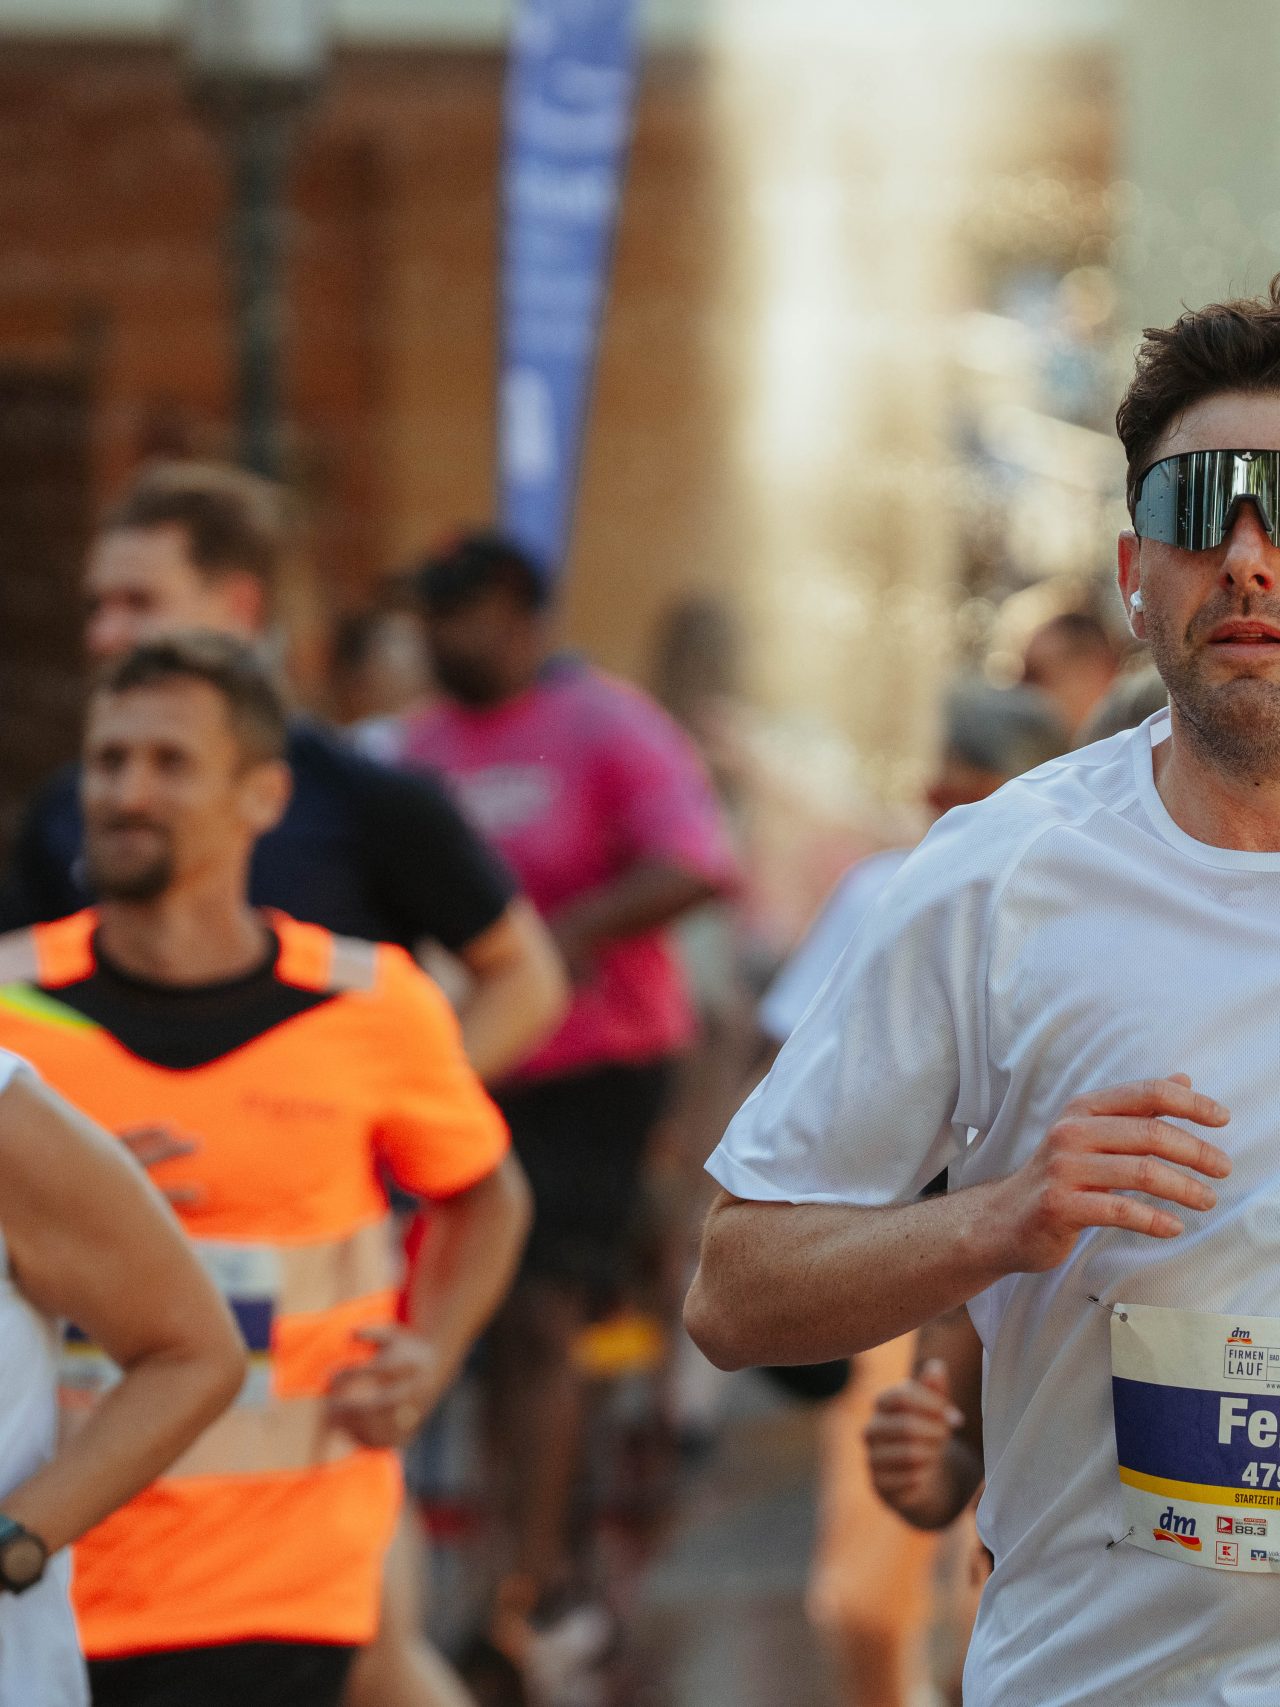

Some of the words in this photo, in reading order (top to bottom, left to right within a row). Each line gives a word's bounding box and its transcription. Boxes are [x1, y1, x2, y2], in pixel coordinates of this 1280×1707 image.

[1231, 1327, 1250, 1338] dm
[1228, 1349, 1264, 1360] FIRMEN
[1228, 1361, 1263, 1376] LAUF
[1234, 1493, 1274, 1506] STARTZEIT
[1159, 1506, 1197, 1536] dm
[1234, 1525, 1267, 1536] 88.3
